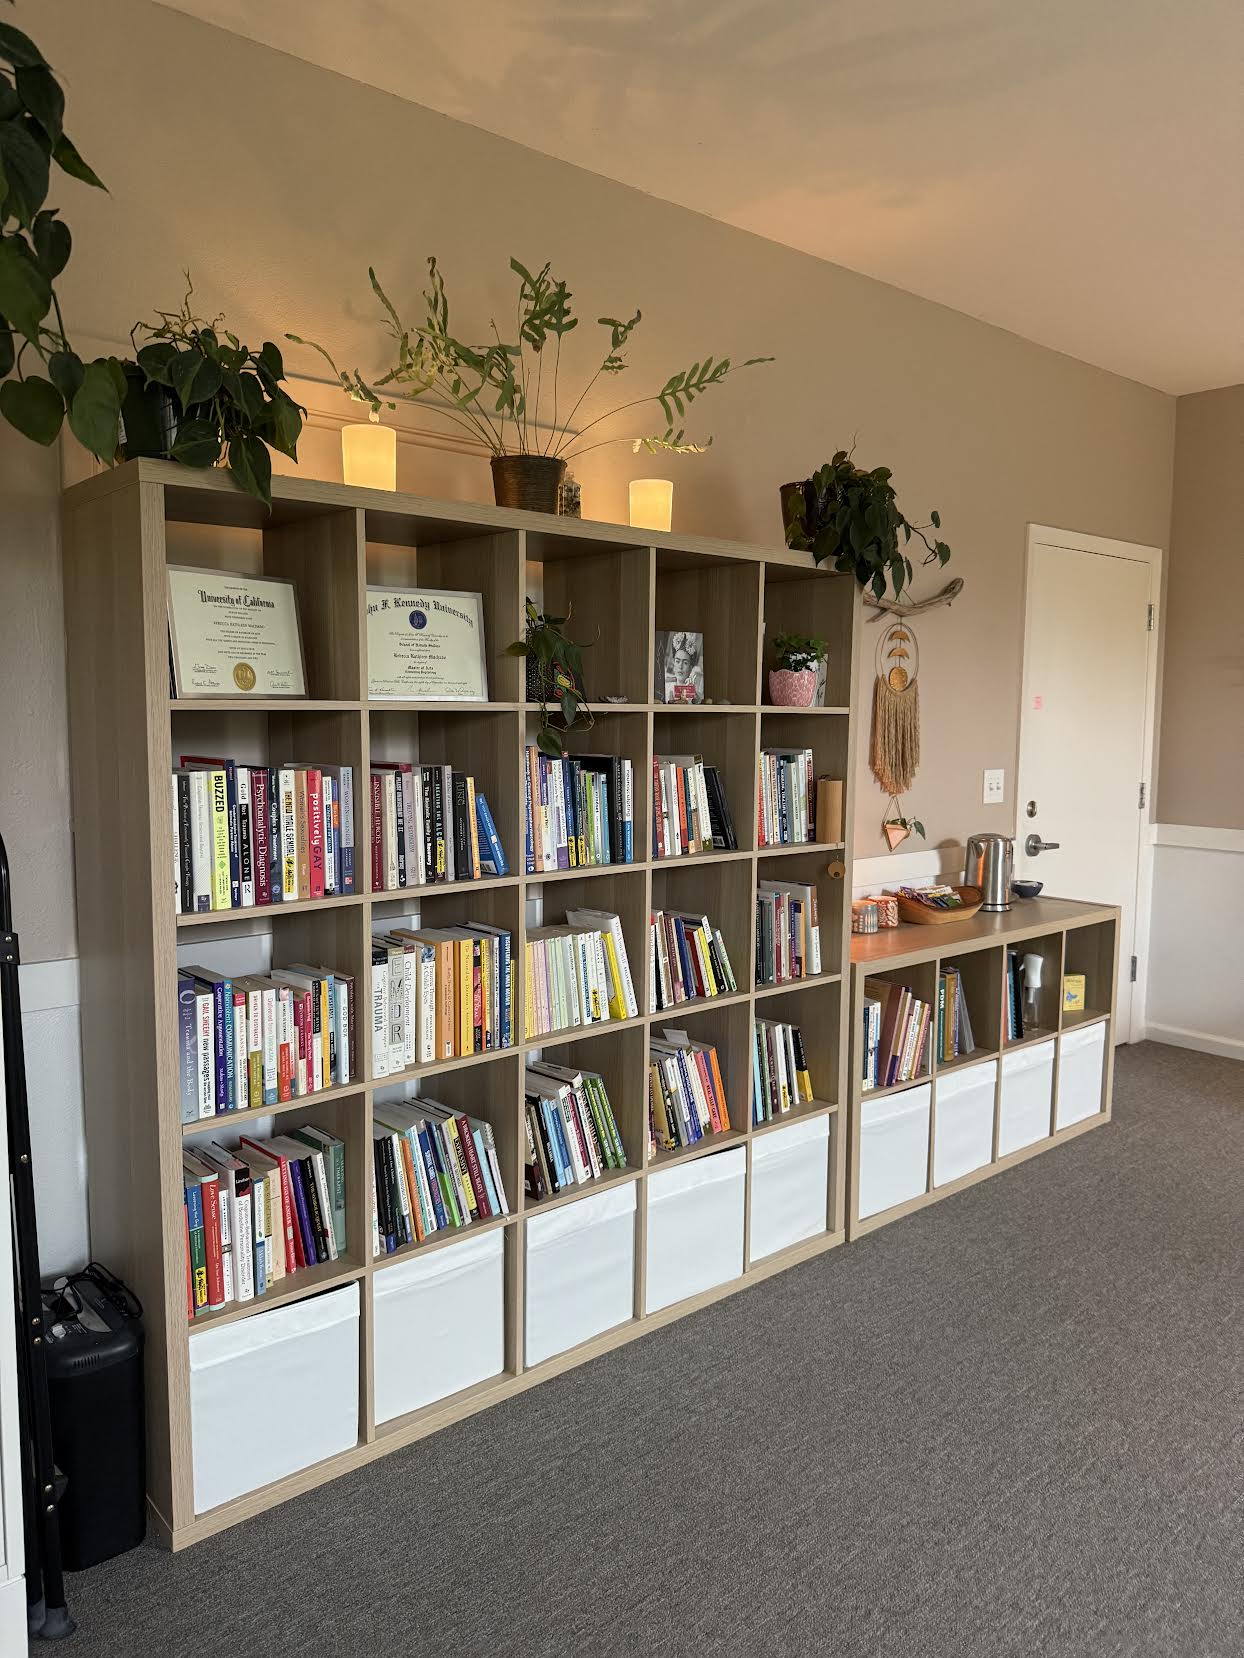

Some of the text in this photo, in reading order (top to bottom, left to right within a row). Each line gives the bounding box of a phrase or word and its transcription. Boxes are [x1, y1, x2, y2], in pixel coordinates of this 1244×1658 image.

[197, 589, 235, 607] University
[235, 596, 243, 606] of
[243, 594, 276, 609] California
[393, 597, 431, 612] Kennedy
[433, 599, 474, 629] University
[214, 775, 225, 813] BUZZED
[256, 783, 268, 888] Psychoanalytic Diagnosis
[310, 793, 323, 870] positively GAY
[404, 960, 412, 1027] Child Development
[374, 988, 382, 1033] TRAUMA
[185, 1023, 193, 1053] Trauma
[202, 1016, 210, 1037] SHEEHY
[226, 1025, 235, 1079] COMMUNICATION
[202, 1052, 210, 1082] passages
[186, 1076, 195, 1096] Body
[463, 1124, 472, 1146] BROKEN
[589, 1117, 598, 1144] CHILD
[455, 1138, 467, 1176] EXPRESSIVE
[468, 1145, 477, 1163] HEART
[236, 1177, 249, 1185] Linehan
[472, 1163, 480, 1178] STILL
[284, 1185, 290, 1195] GO
[475, 1177, 484, 1193] BEATS
